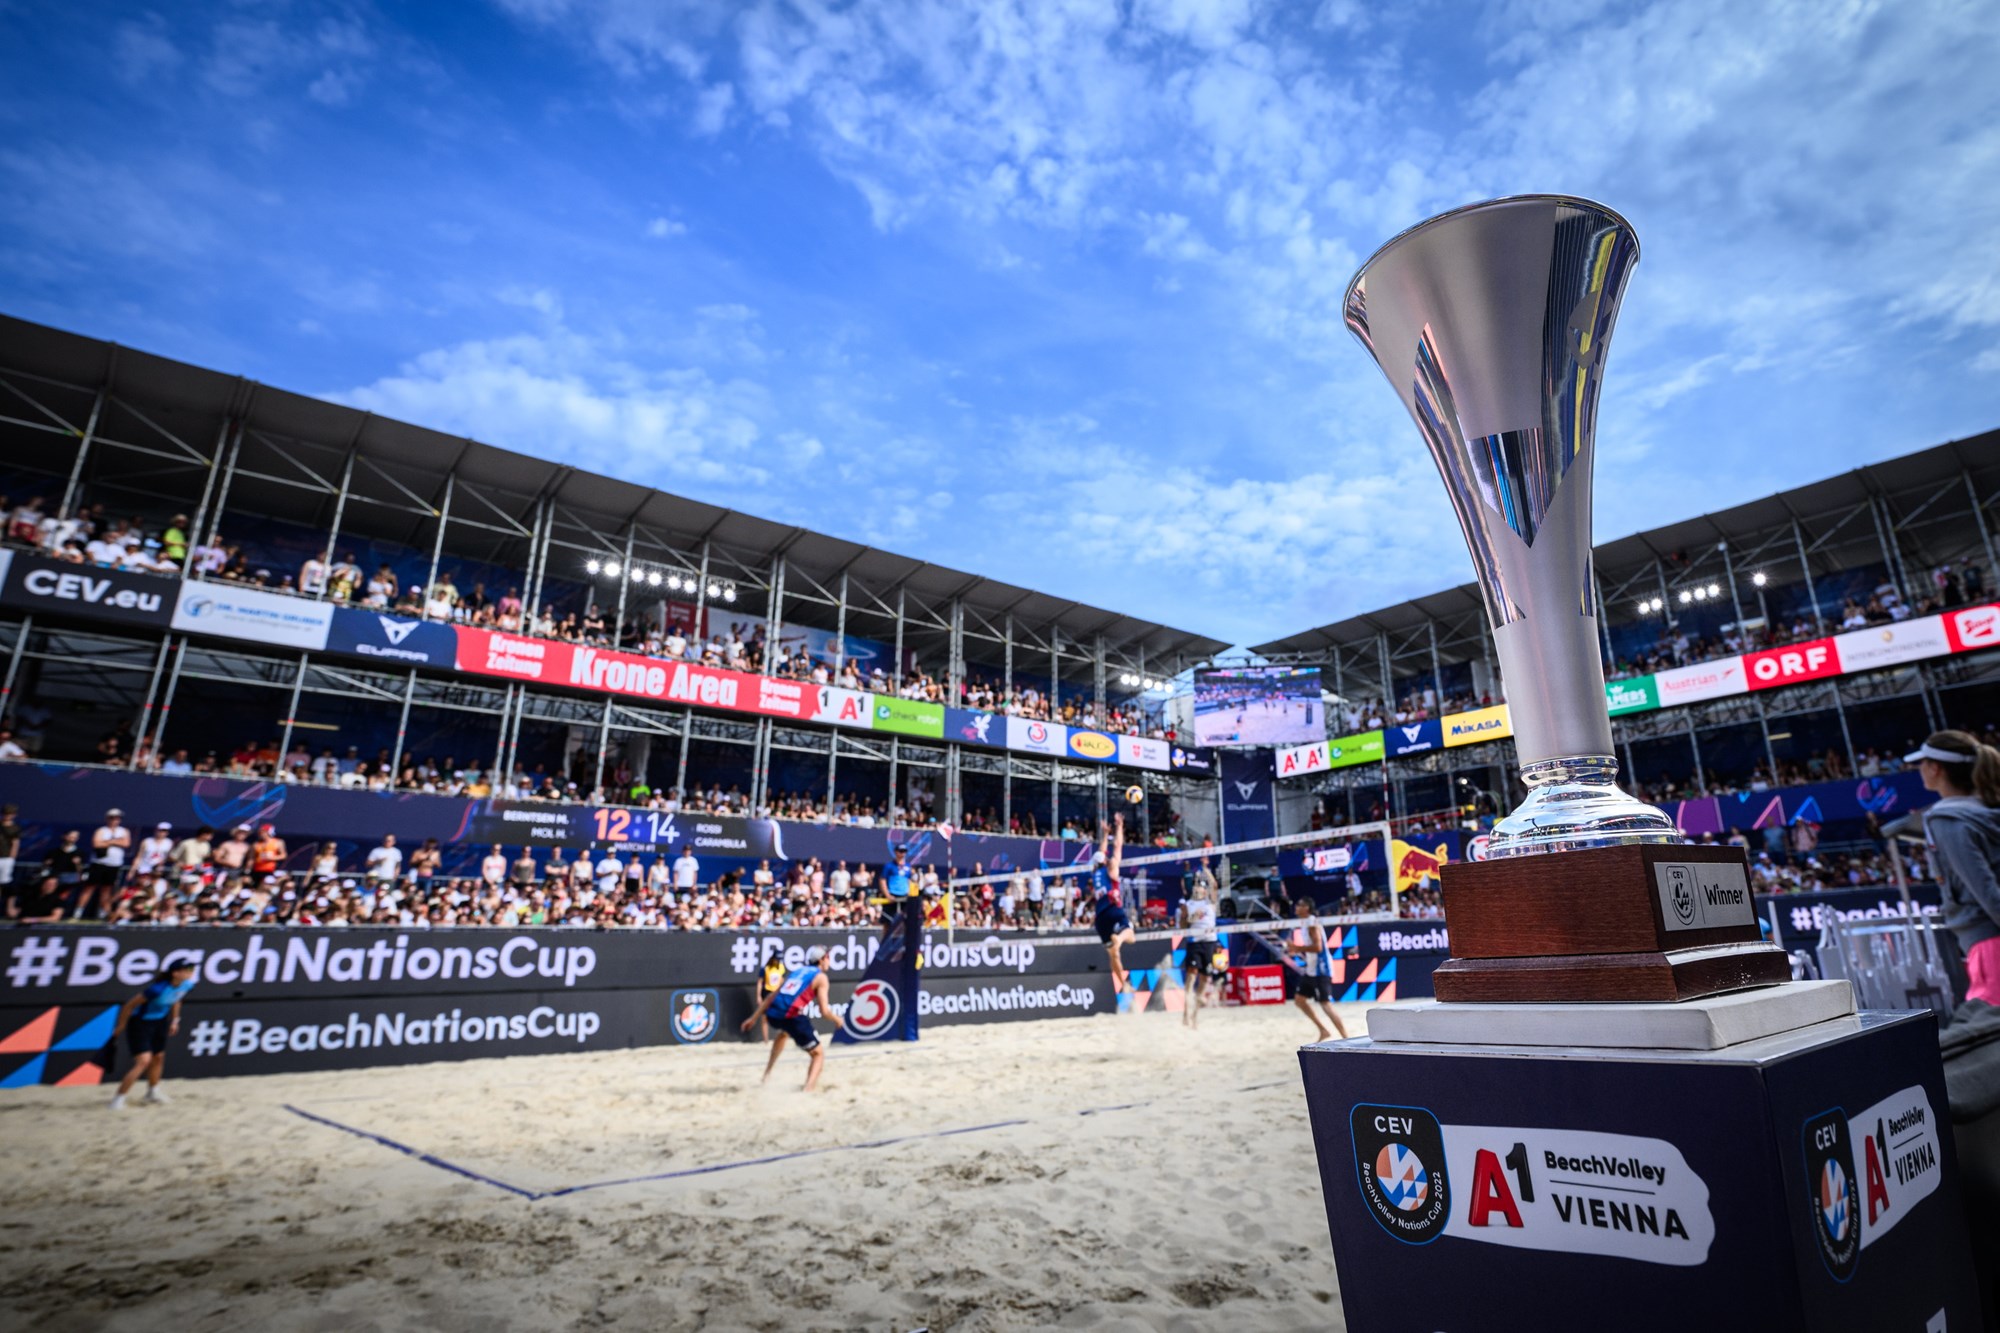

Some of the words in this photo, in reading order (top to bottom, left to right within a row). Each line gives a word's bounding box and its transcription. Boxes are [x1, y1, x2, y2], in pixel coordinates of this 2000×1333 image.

[23, 568, 161, 613] CEV.eu
[489, 633, 545, 660] Kronen
[485, 651, 543, 678] Zeitung
[569, 646, 667, 697] Krone
[668, 662, 739, 708] Area
[1753, 646, 1828, 681] ORF
[759, 677, 802, 700] Kronen
[1663, 674, 1719, 692] Austrian
[758, 693, 801, 716] Zeitung
[839, 695, 865, 721] A1
[1283, 751, 1299, 774] A1
[1307, 746, 1323, 769] A1
[593, 808, 631, 841] 12
[646, 811, 681, 844] 14
[1672, 870, 1684, 880] CEV
[1703, 883, 1744, 906] Winner
[683, 992, 707, 1005] CEV
[187, 1005, 601, 1058] #BeachNationsCup
[1374, 1115, 1413, 1135] CEV
[1888, 1105, 1925, 1137] BeachVolley
[1815, 1122, 1837, 1151] CEV
[1544, 1149, 1666, 1187] BeachVolley
[1864, 1116, 1891, 1228] A1
[1894, 1141, 1937, 1187] VIENNA
[1363, 1162, 1397, 1223] BeachVolley
[1432, 1171, 1443, 1200] 2022
[1467, 1141, 1536, 1229] A1
[1398, 1217, 1430, 1231] Nations
[1428, 1201, 1442, 1220] Cup
[1550, 1193, 1691, 1241] VIENNA
